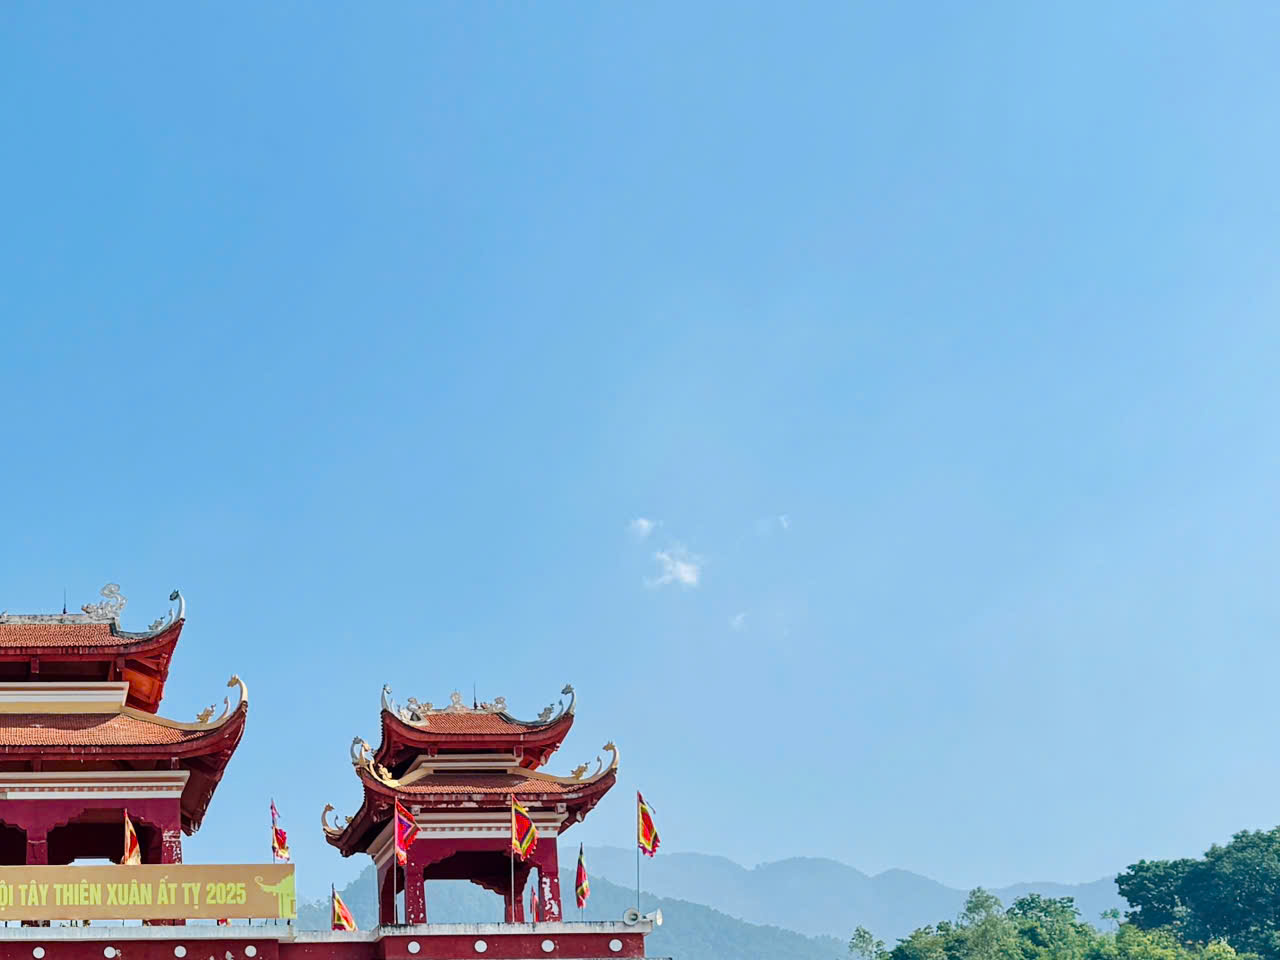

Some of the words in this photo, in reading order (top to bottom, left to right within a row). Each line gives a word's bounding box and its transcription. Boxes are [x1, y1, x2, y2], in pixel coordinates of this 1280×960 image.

[19, 880, 49, 905] TÂY
[54, 879, 102, 905] THIÊN
[107, 879, 152, 905] XUÂN
[157, 875, 178, 905] ẤT
[206, 882, 247, 905] 2025
